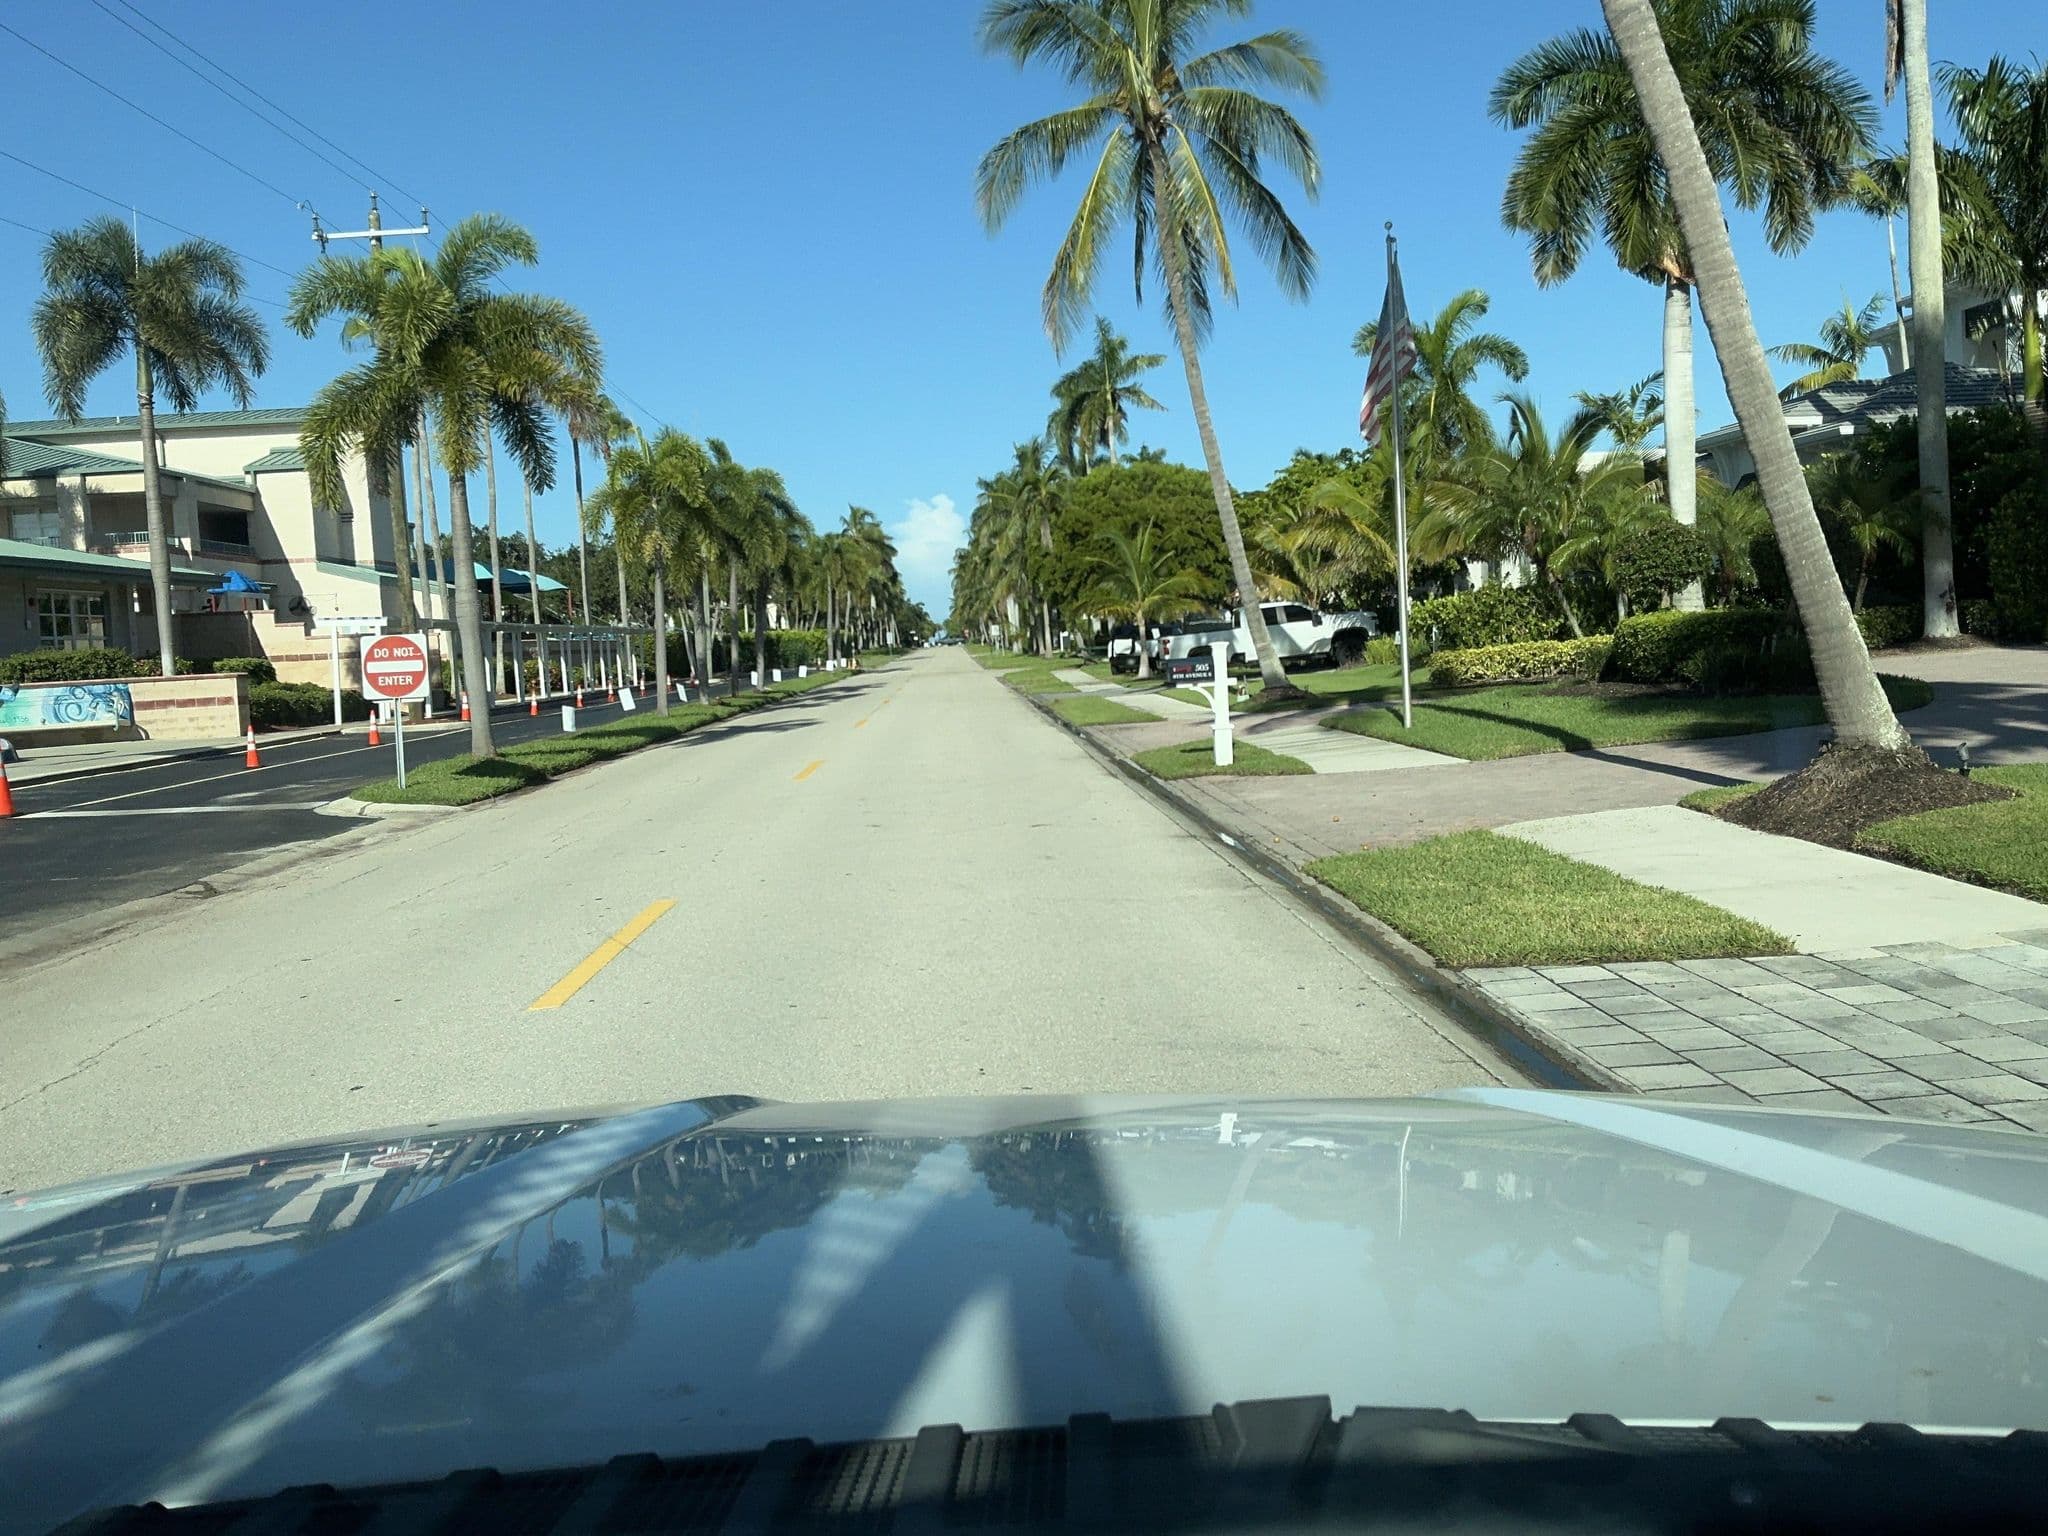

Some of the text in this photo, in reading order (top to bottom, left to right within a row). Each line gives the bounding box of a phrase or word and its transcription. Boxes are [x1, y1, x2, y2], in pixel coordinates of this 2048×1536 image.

[374, 647, 415, 658] DO NOT
[1194, 663, 1209, 672] 505
[378, 675, 413, 686] ENTER
